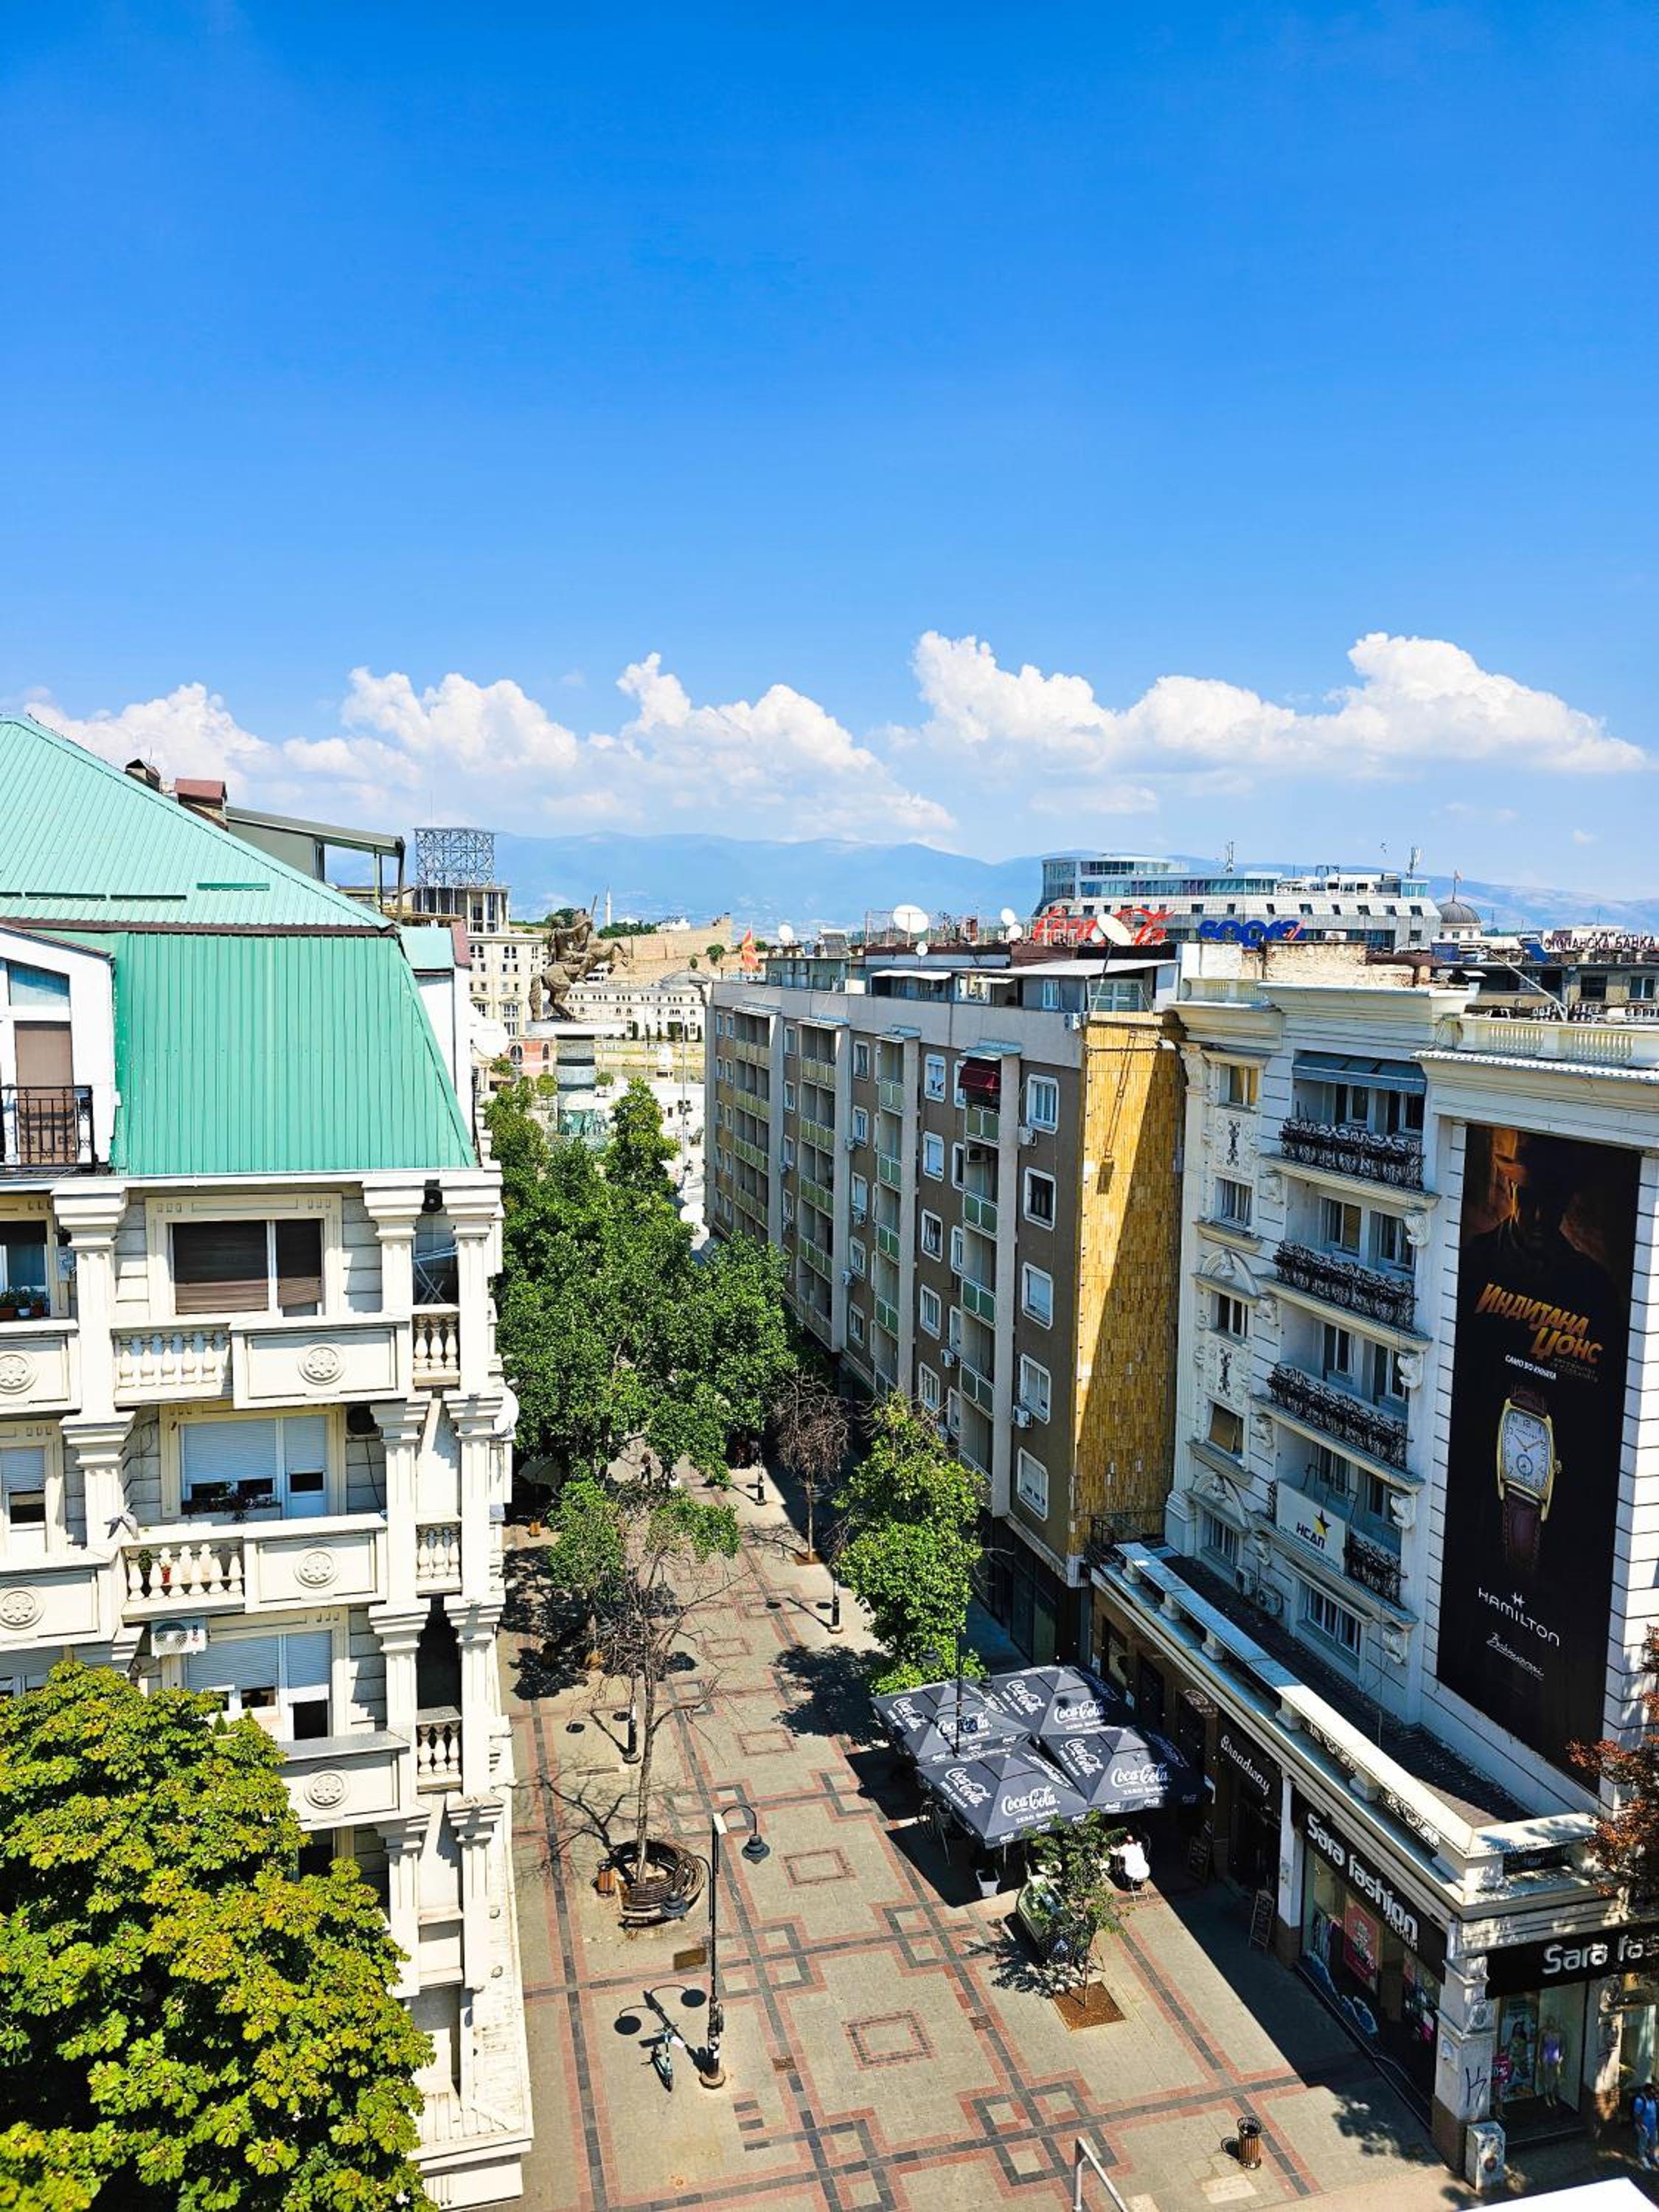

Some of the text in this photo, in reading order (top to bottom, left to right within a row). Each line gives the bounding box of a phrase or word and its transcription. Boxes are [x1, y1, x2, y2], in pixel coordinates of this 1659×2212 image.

[1615, 934, 1655, 950] БАНКА
[1475, 1283, 1590, 1338] ИНДИЈАНА
[1530, 1327, 1604, 1364] ЏОНС
[1478, 1587, 1559, 1646] HAMILTON
[936, 1707, 990, 1738] Coc-Cola
[1054, 1698, 1105, 1724] Coca-Cola
[1111, 1763, 1169, 1787] Coca-Cola
[1221, 1735, 1270, 1795] Broadway
[945, 1767, 994, 1804] Coca-Cola
[1001, 1785, 1057, 1816] Coca-Cola
[1307, 1813, 1345, 1866] Sara
[1349, 1855, 1418, 1941] fashion
[1542, 1943, 1608, 1975] Sara
